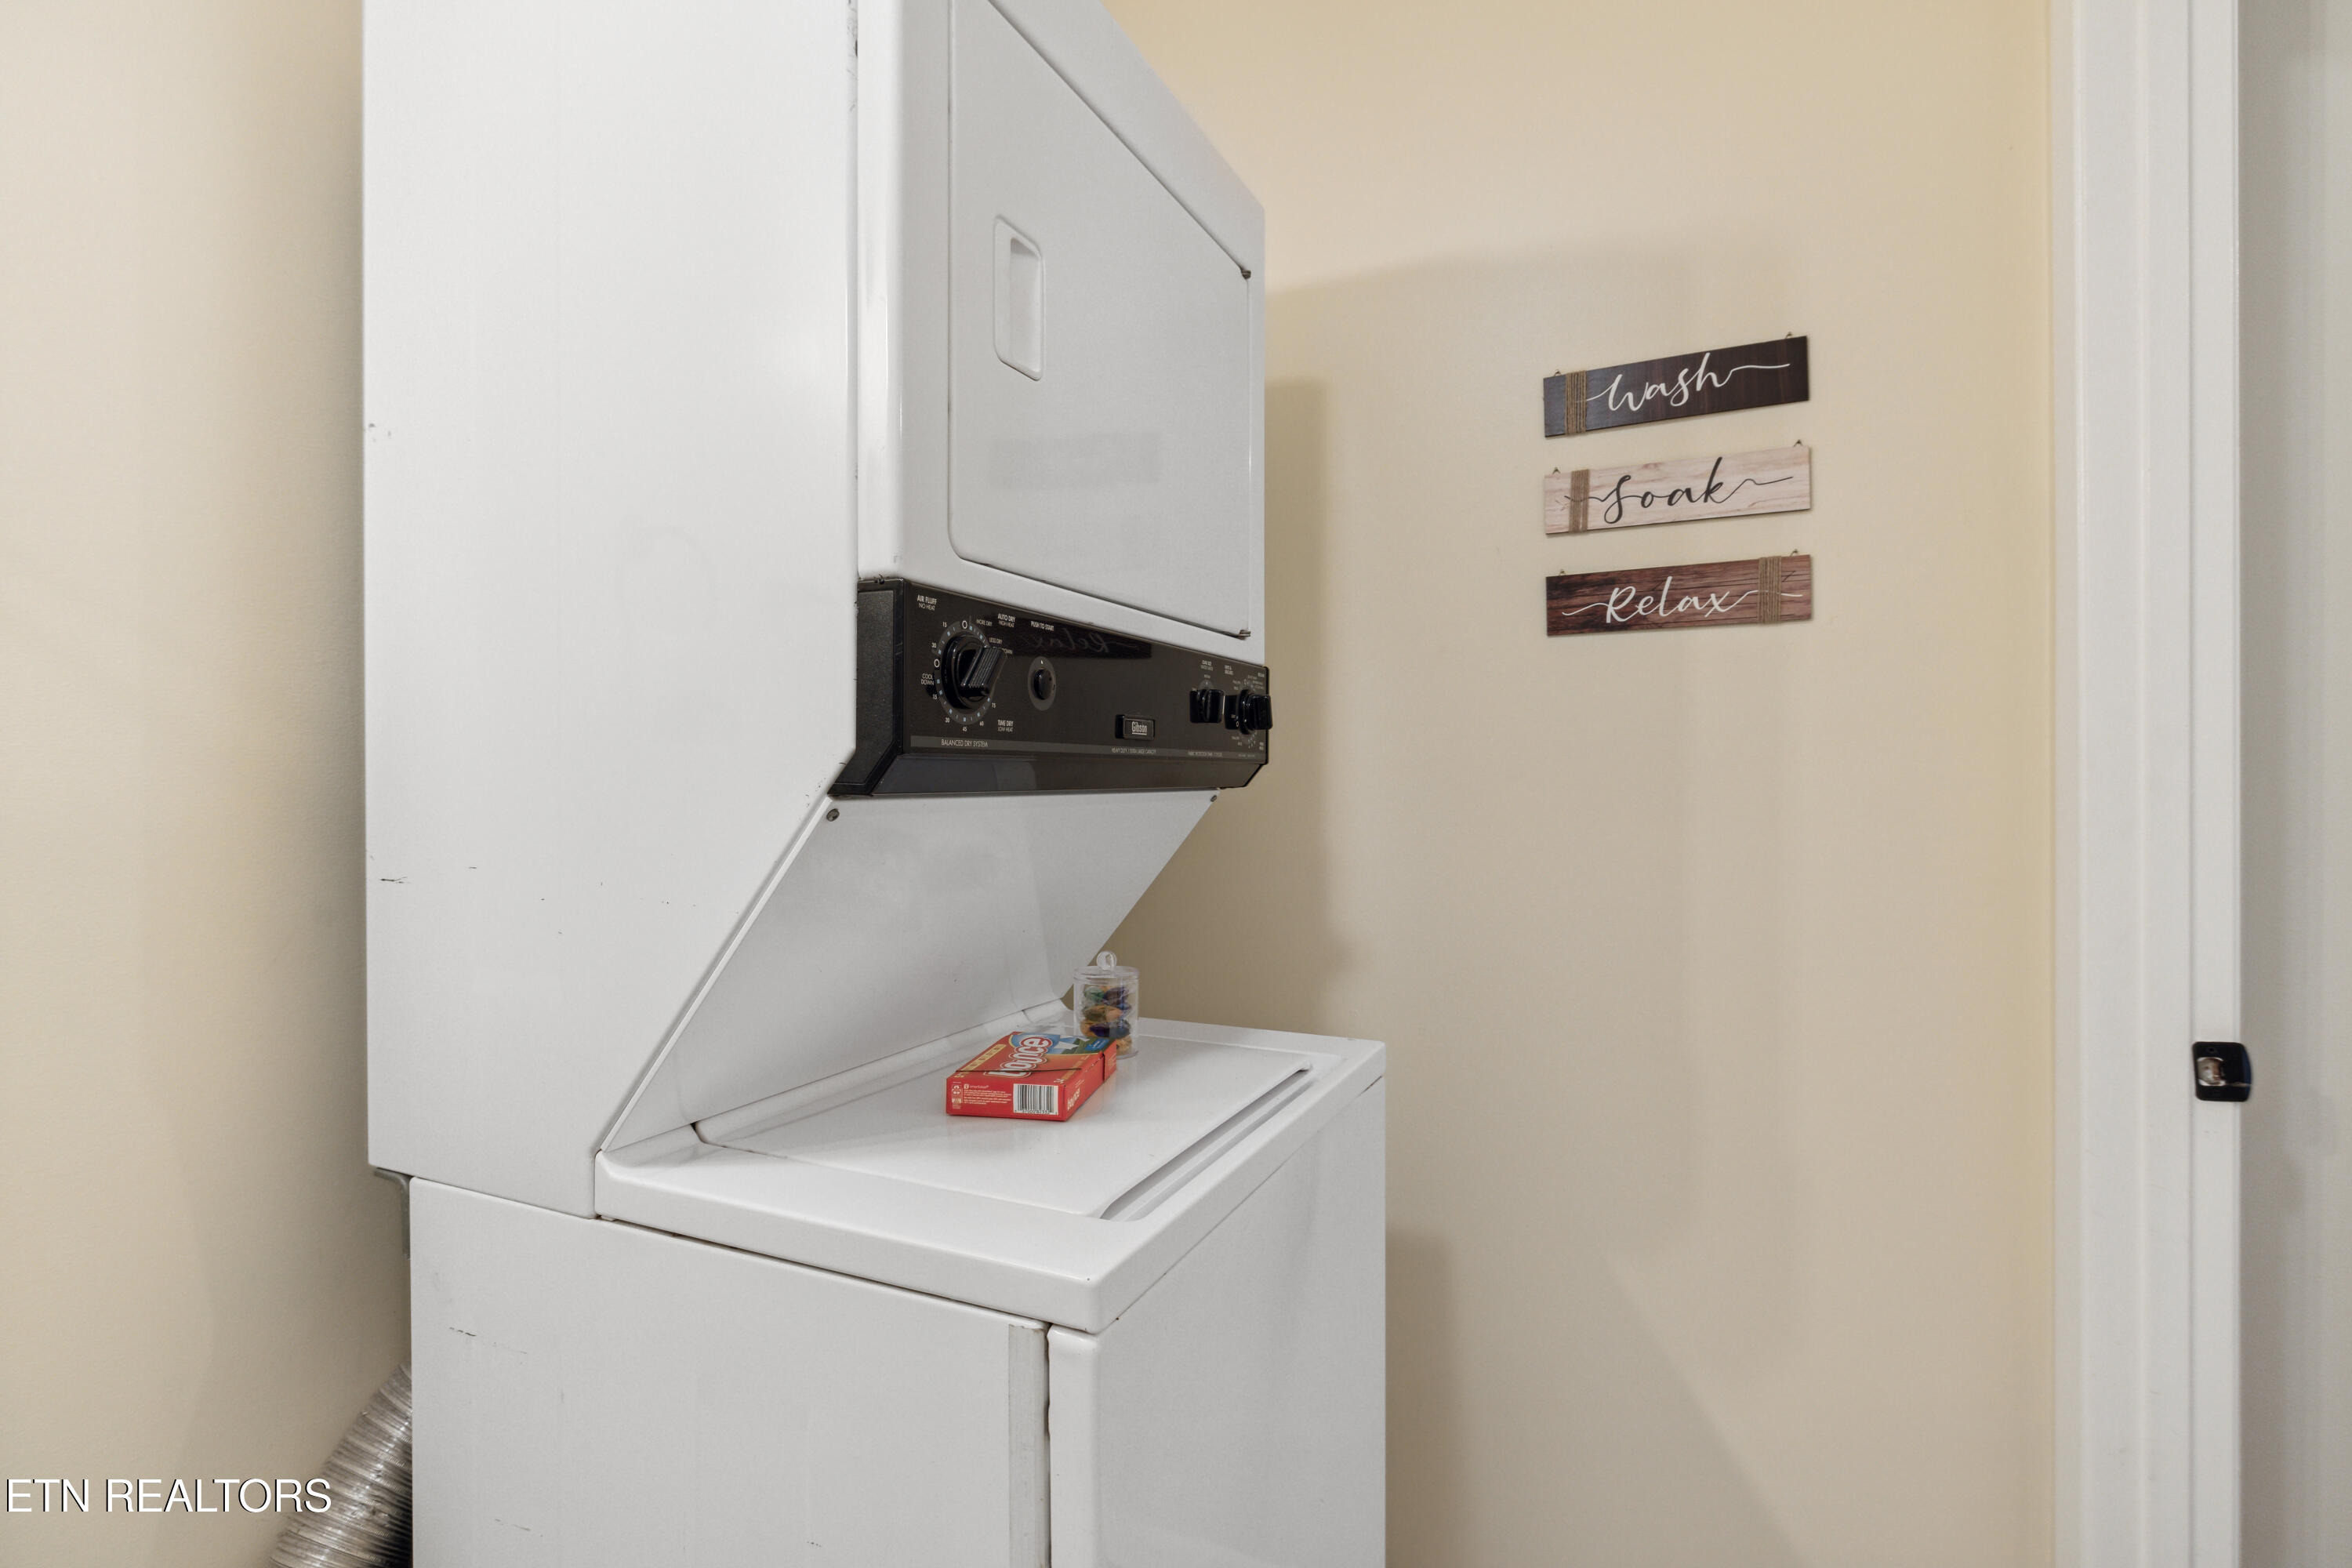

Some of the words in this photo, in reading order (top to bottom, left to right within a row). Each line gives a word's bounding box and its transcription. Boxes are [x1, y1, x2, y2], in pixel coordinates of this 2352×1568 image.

[916, 594, 925, 603] AIR
[925, 596, 938, 605] FLUFF
[1562, 575, 1761, 624] Relax
[1131, 720, 1148, 733] Gibson
